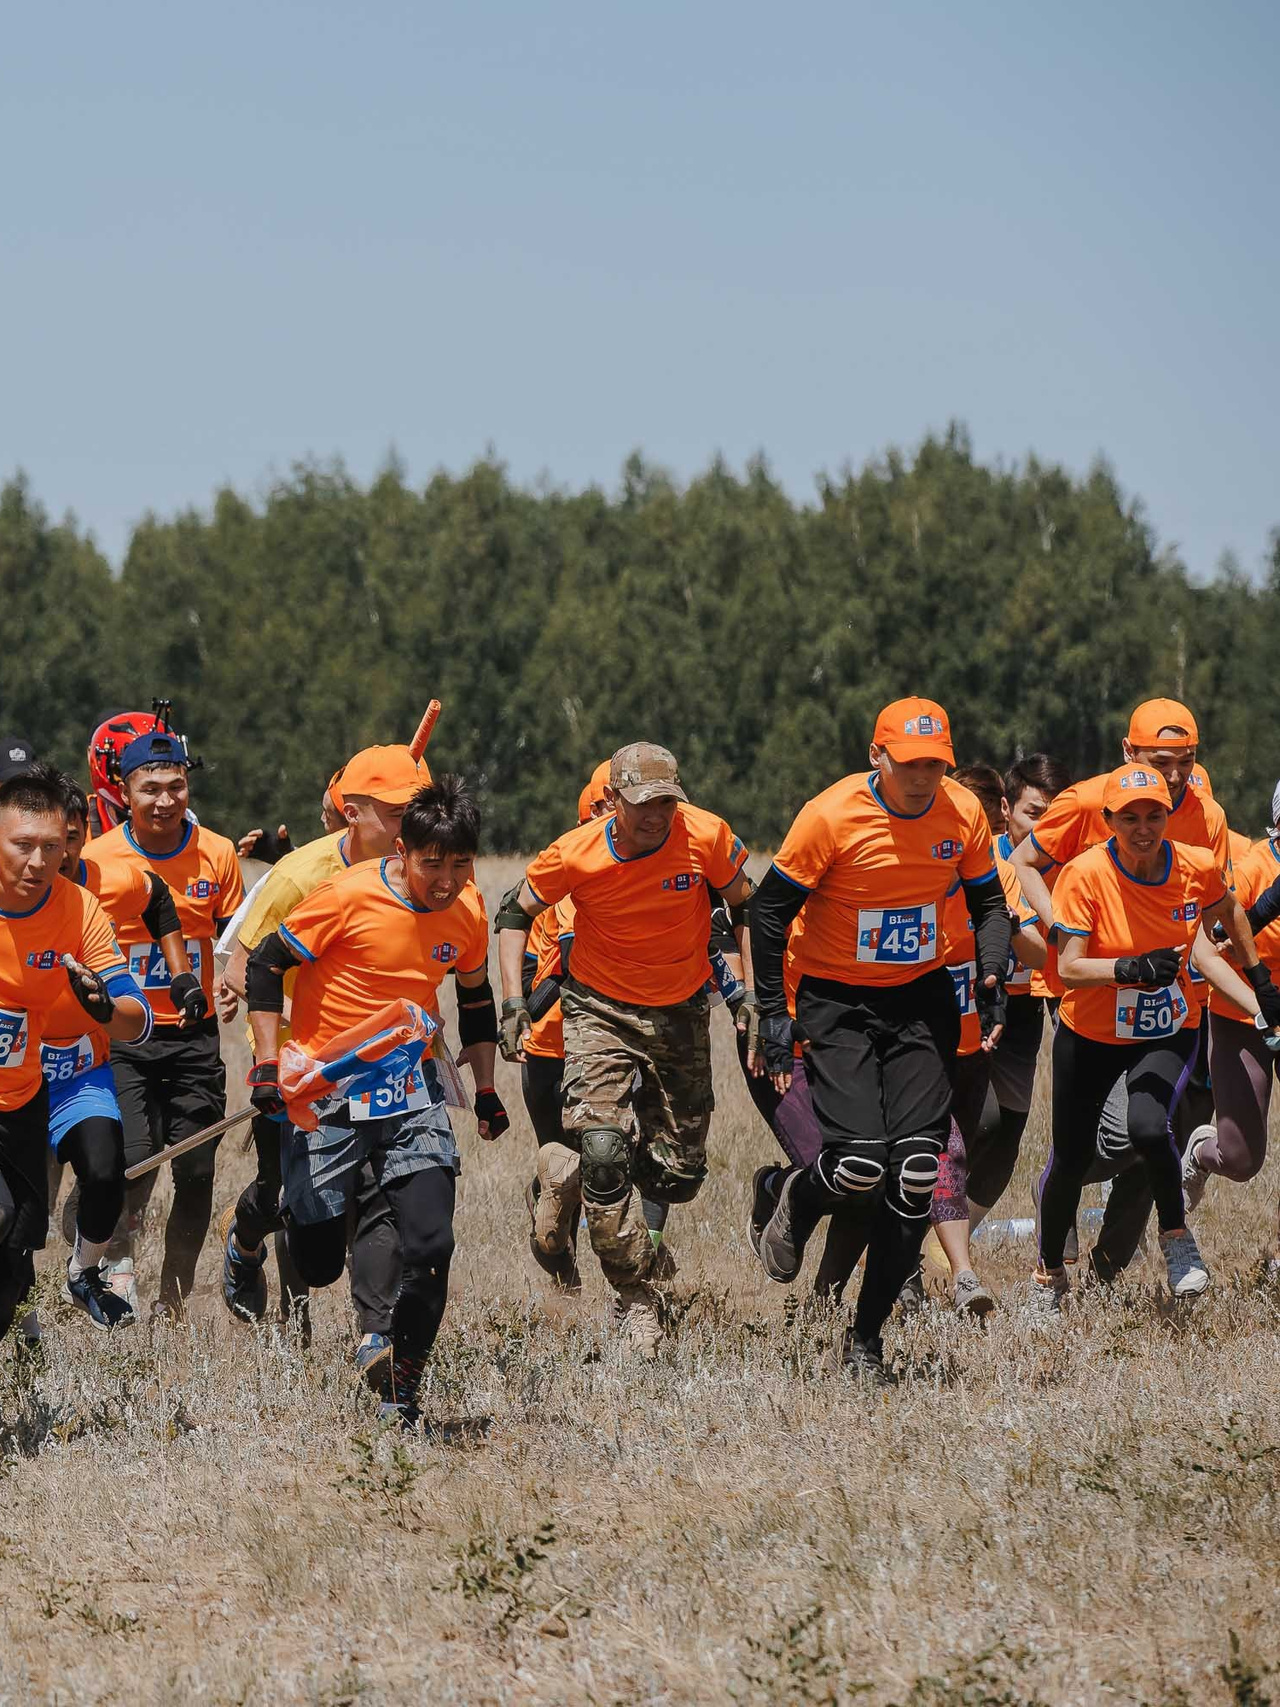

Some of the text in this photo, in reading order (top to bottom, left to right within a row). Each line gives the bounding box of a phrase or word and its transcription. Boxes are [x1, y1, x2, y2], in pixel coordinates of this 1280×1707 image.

[889, 915, 902, 925] BI
[882, 926, 920, 954] 45
[1143, 999, 1157, 1007] BI
[1139, 1006, 1172, 1031] 50
[47, 1052, 61, 1061] BI
[42, 1061, 75, 1082] 58
[375, 1076, 406, 1108] 58
